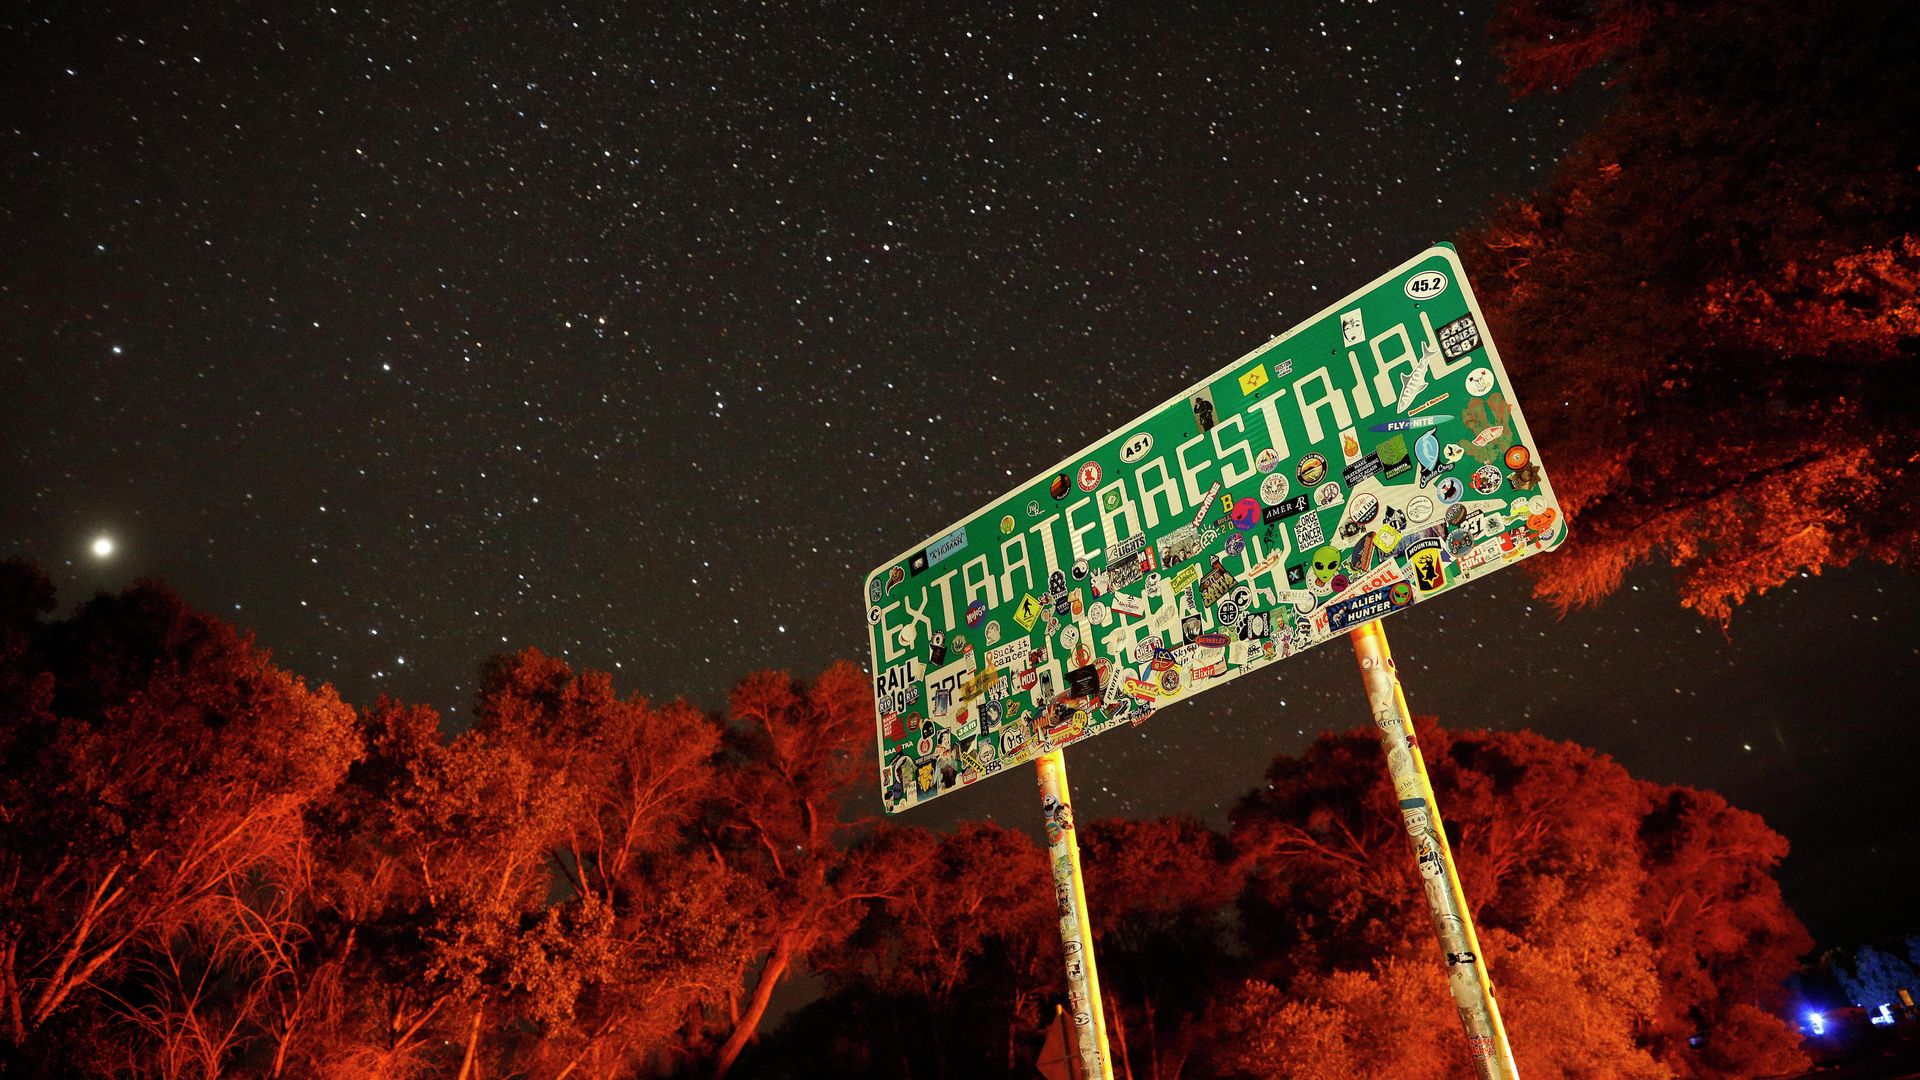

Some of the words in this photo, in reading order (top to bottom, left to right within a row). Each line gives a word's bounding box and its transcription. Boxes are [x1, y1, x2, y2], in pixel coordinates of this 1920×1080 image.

[1411, 278, 1440, 292] 45.2
[1388, 422, 1405, 431] FLY
[1412, 418, 1434, 428] NITE
[1124, 436, 1149, 458] A51
[1194, 482, 1220, 526] KOMINE
[1296, 521, 1318, 533] SAYS
[1298, 528, 1322, 544] CANCER
[1300, 537, 1323, 551] SUCKS
[1119, 537, 1145, 556] LIGHTS
[1409, 540, 1438, 554] MOUNTAIN
[1362, 570, 1399, 593] ROLL
[1352, 592, 1382, 609] ALIEN
[1348, 601, 1391, 622] HUNTER
[993, 645, 1014, 659] Suck
[1136, 644, 1152, 658] AREA
[878, 662, 915, 696] RAIL
[1192, 666, 1215, 680] Elixir
[961, 753, 982, 772] SMITH
